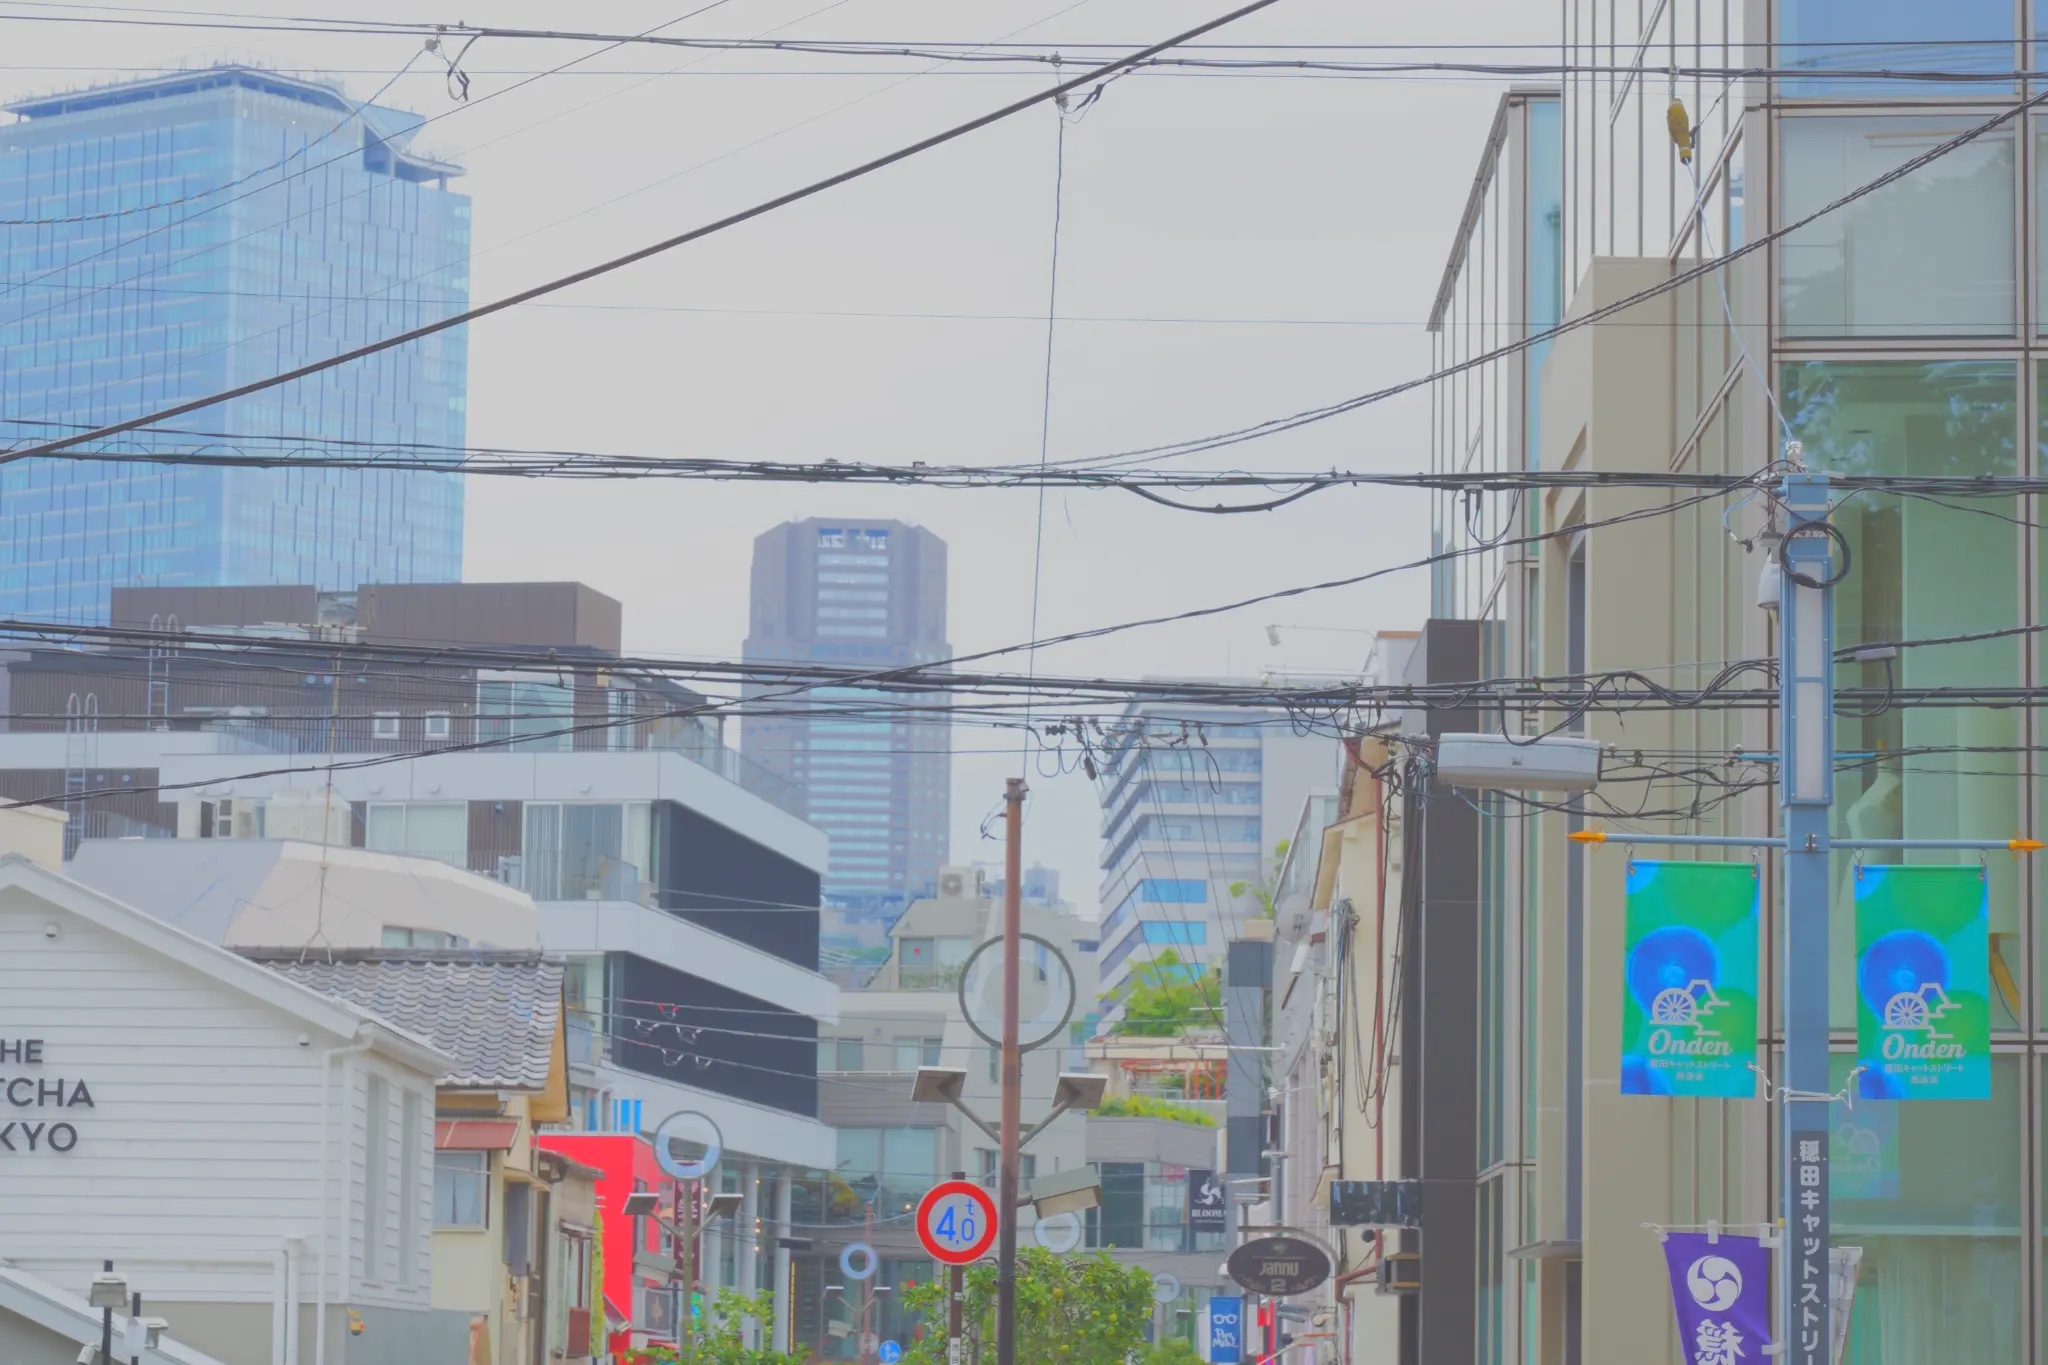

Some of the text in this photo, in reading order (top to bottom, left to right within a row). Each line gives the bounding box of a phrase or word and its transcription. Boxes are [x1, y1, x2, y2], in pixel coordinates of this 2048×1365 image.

[0, 1039, 44, 1064] HE
[1648, 1028, 1733, 1056] Onden
[1882, 1033, 1967, 1060] Onden
